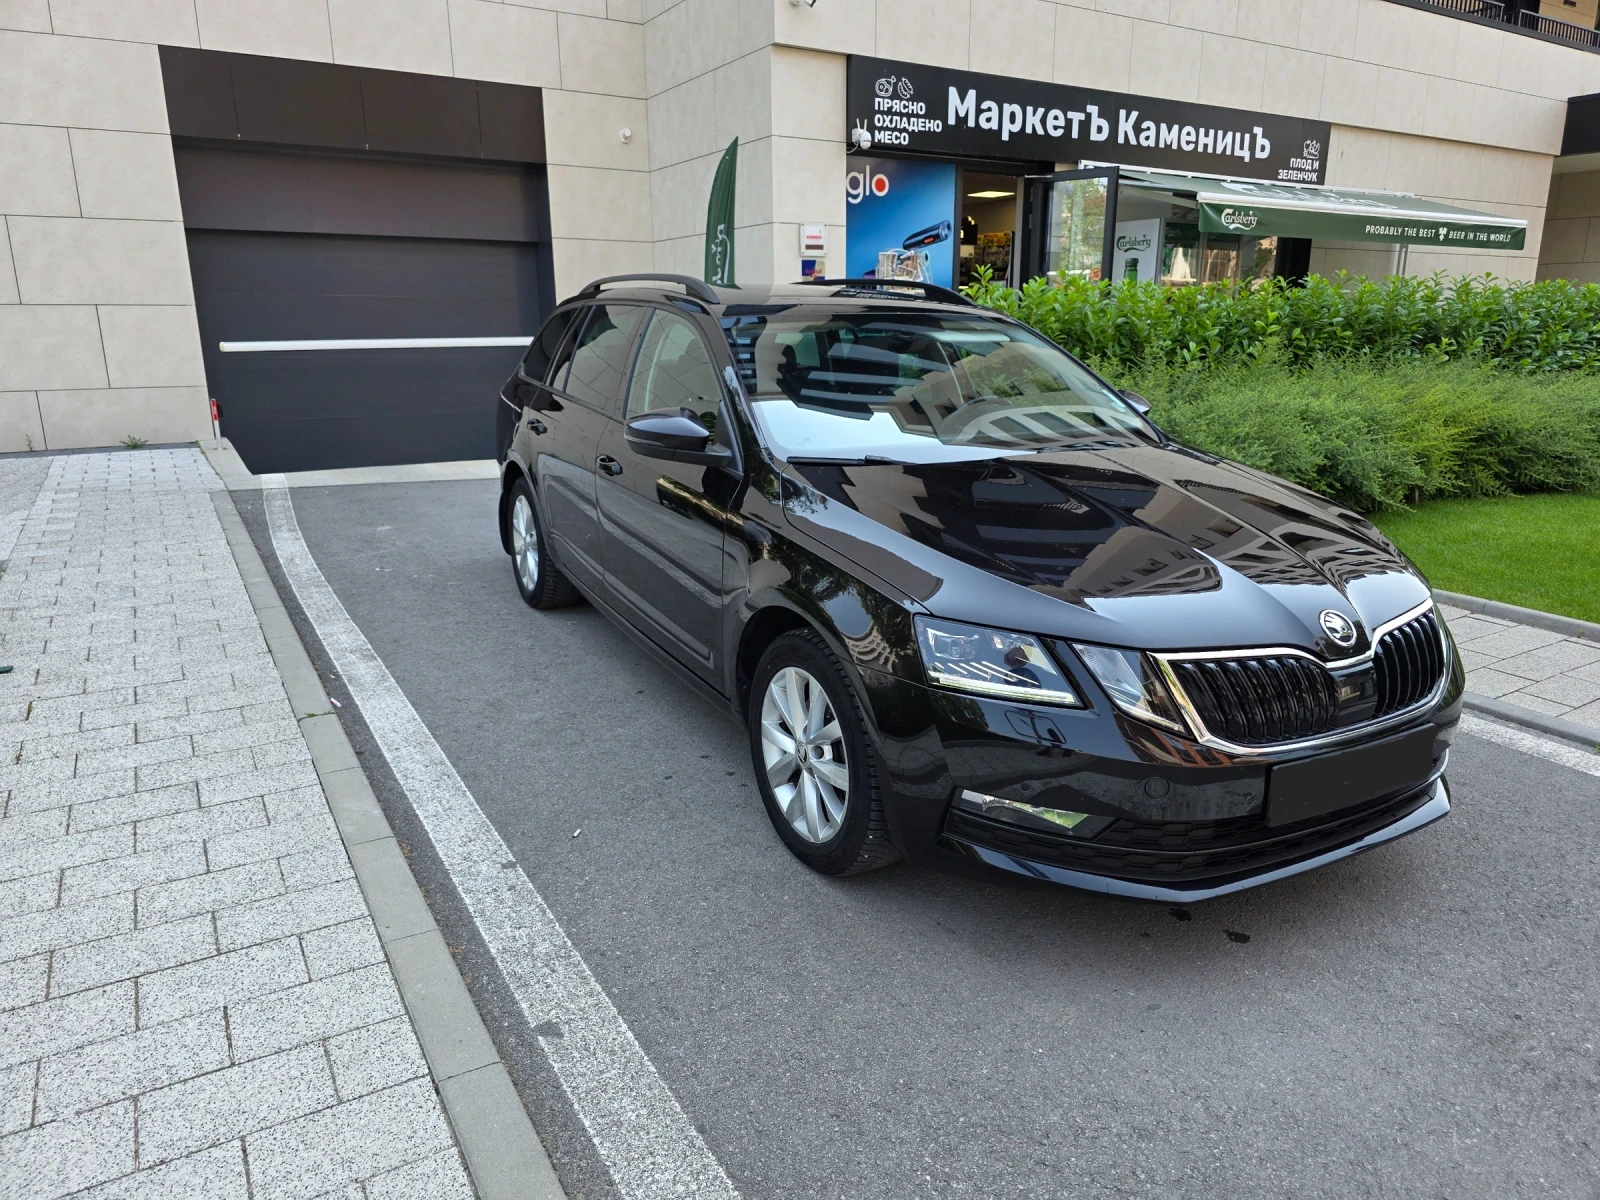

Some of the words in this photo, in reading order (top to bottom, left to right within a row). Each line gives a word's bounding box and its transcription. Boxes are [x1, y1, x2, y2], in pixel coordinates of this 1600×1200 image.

[874, 98, 926, 115] ПРЯСНО
[874, 114, 943, 133] ОХЛАДЕНО
[874, 130, 910, 145] МЕСО
[1290, 157, 1312, 171] ПЛОД
[1313, 160, 1320, 170] И
[1277, 168, 1318, 182] ЗЕЛЕНЧУК
[846, 165, 890, 205] glo
[1221, 208, 1258, 231] Carlsberg
[1365, 224, 1402, 236] PROBABLY
[1404, 227, 1417, 236] THE
[1418, 228, 1436, 238] BEST
[1448, 230, 1466, 240] BEER
[1466, 231, 1474, 240] IN
[1475, 231, 1488, 241] THE
[1489, 232, 1511, 242] WORLD
[1116, 234, 1152, 252] Carlsberg
